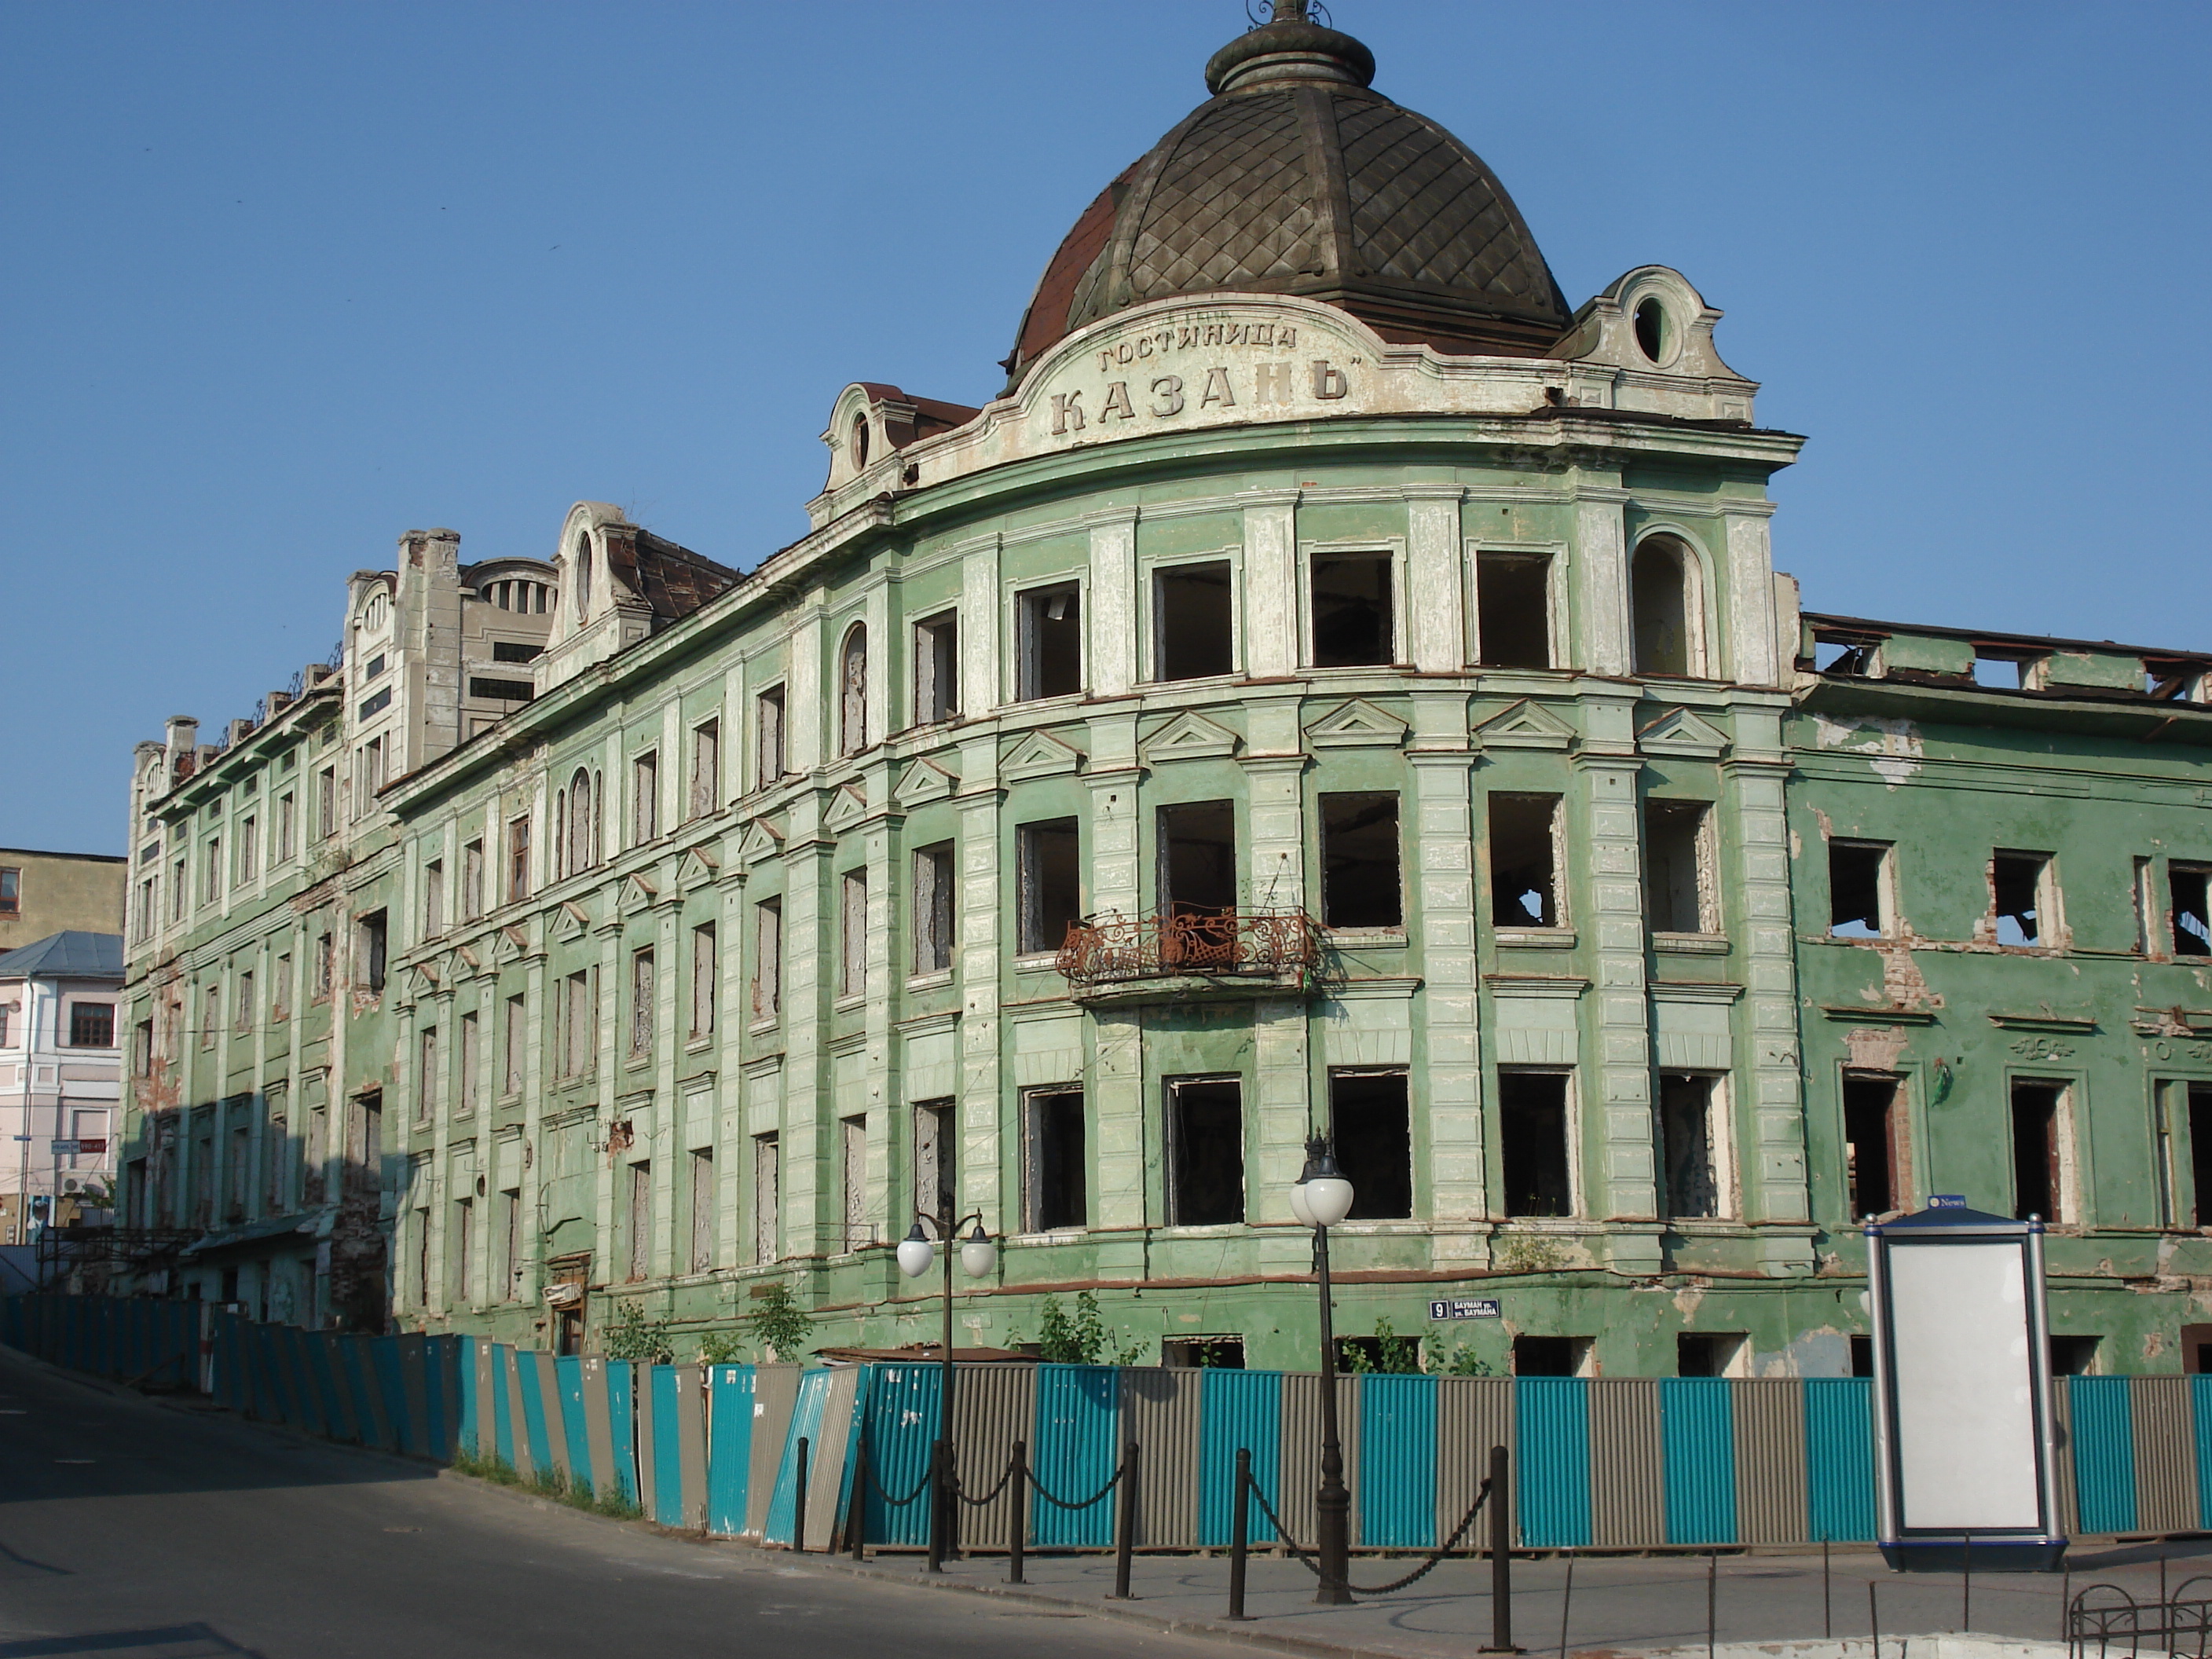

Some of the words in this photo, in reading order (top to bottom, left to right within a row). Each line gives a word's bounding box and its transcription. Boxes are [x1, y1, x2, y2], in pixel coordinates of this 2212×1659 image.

[1096, 323, 1297, 372] ГОСТИНИЦА
[1940, 1198, 1965, 1207] News
[1454, 1301, 1482, 1309] БАУМАН
[1436, 1304, 1444, 1317] 9
[1464, 1307, 1496, 1317] БАУМАНА
